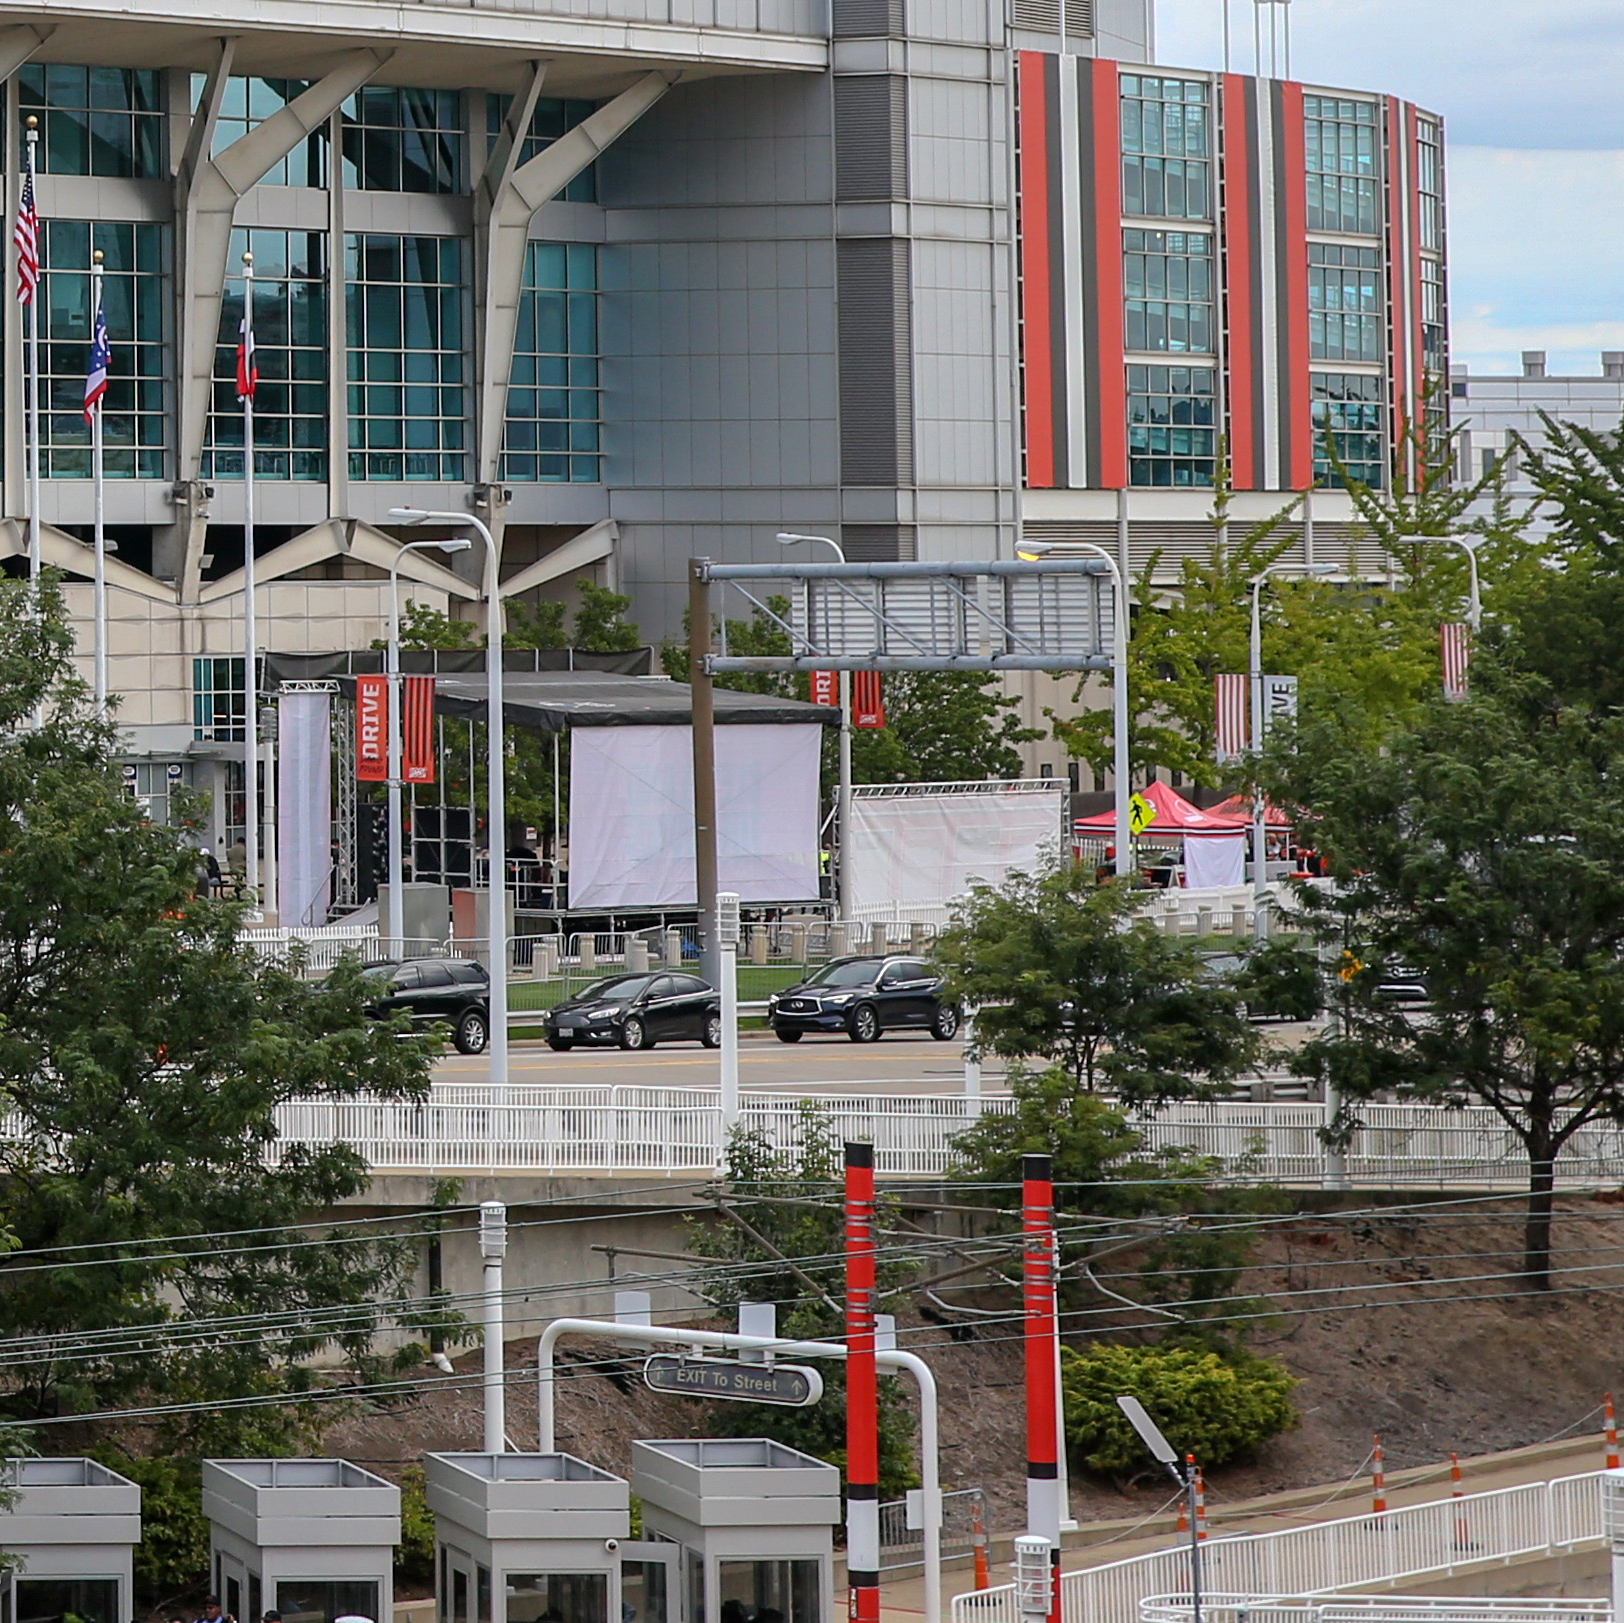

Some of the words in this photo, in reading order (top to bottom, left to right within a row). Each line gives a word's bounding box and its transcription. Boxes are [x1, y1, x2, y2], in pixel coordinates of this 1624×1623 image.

[816, 670, 832, 706] DRI
[1272, 682, 1290, 717] IVE
[362, 683, 380, 759] DRIVE
[677, 1368, 706, 1384] EXIT
[713, 1372, 728, 1387] To
[734, 1375, 778, 1393] Street
